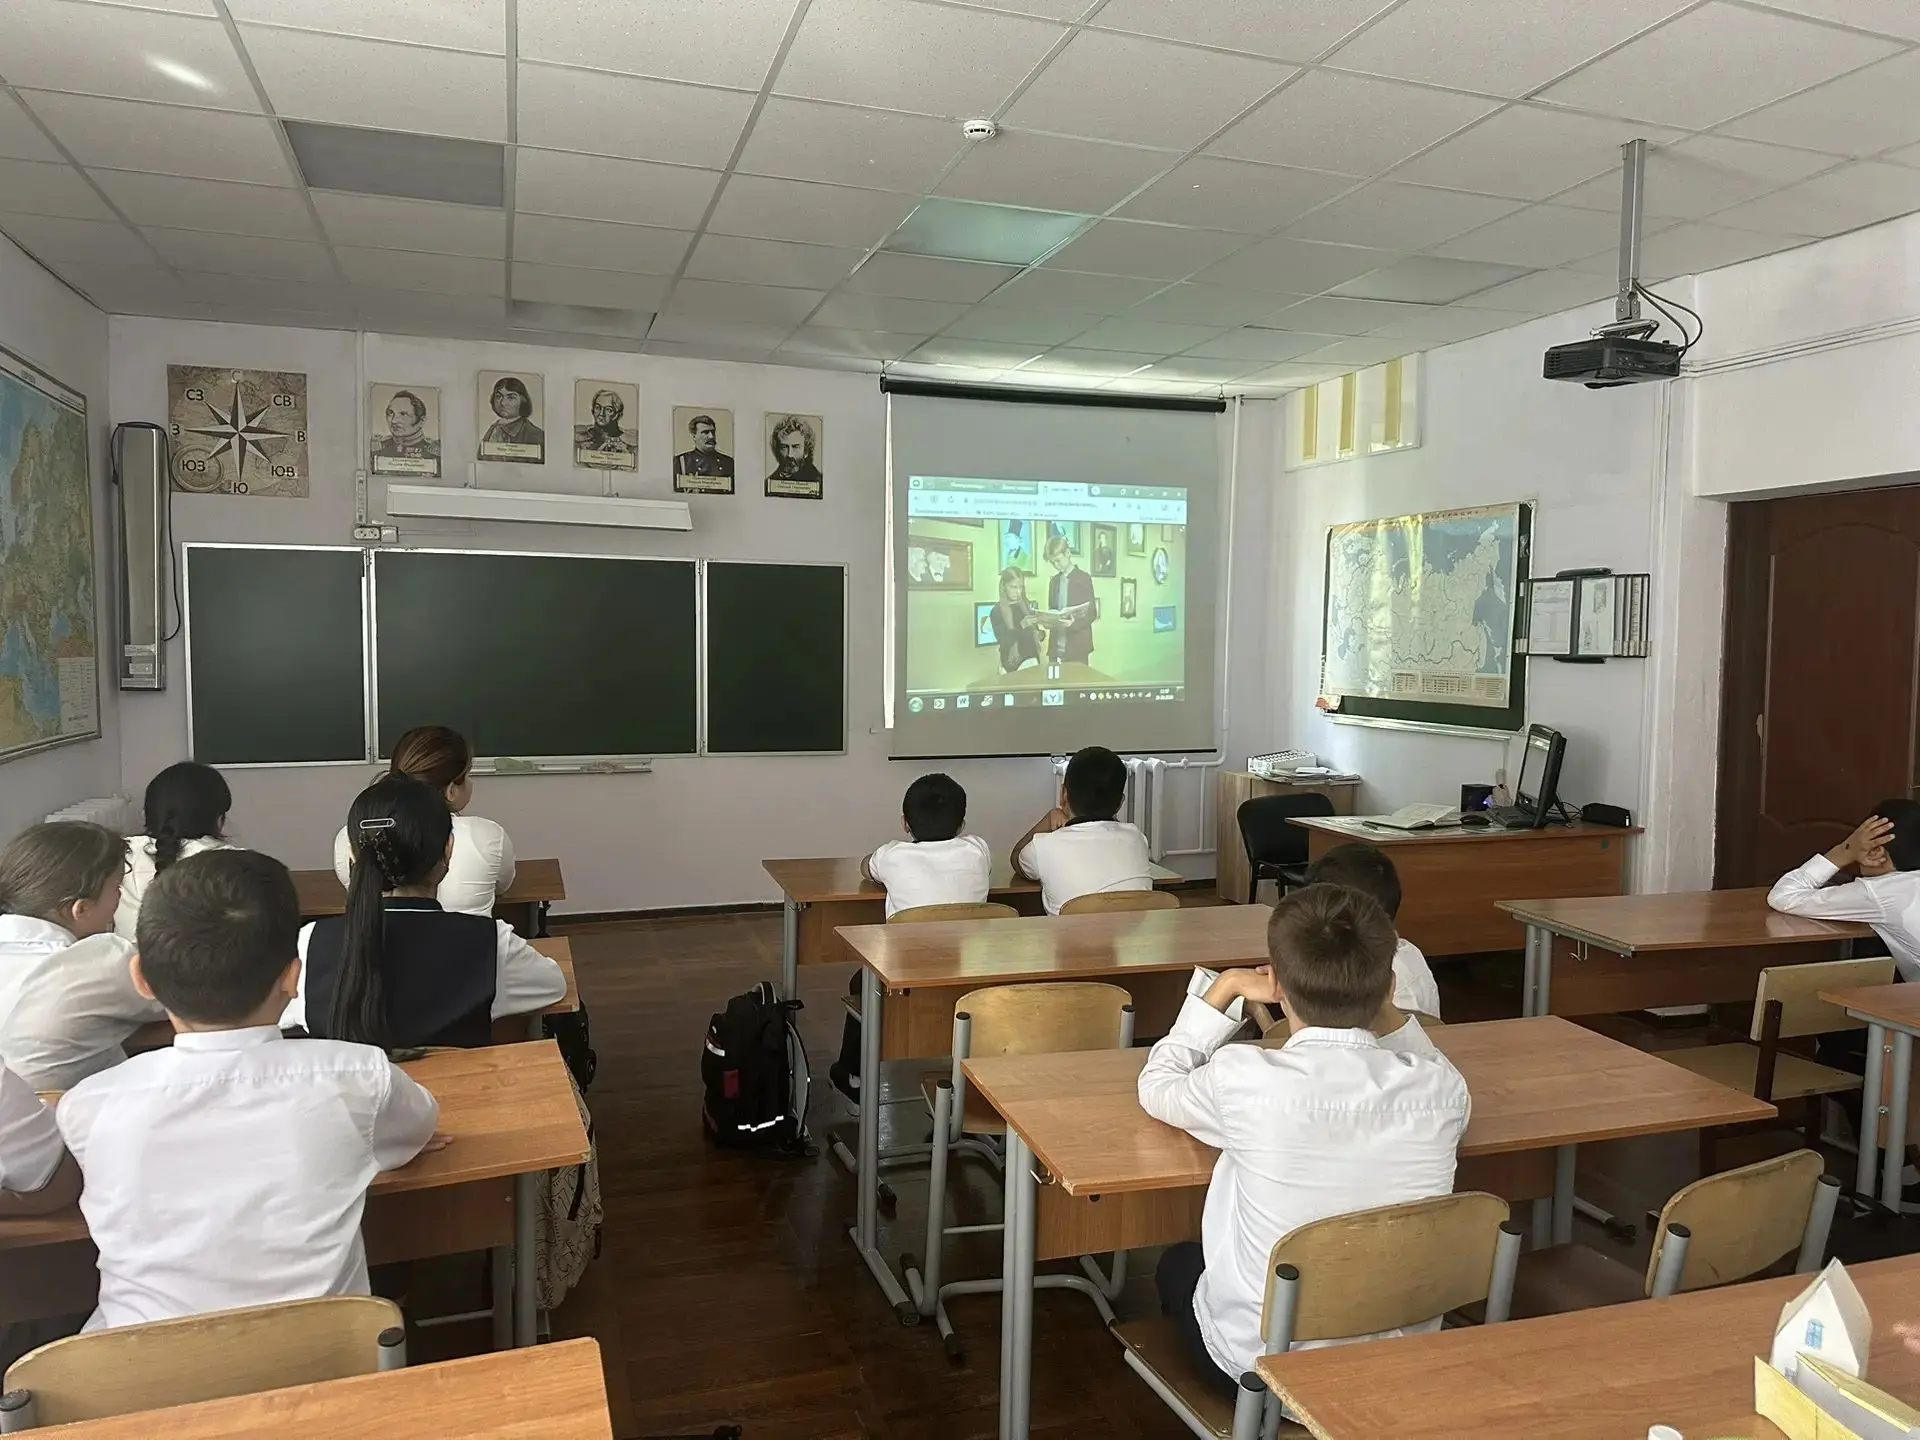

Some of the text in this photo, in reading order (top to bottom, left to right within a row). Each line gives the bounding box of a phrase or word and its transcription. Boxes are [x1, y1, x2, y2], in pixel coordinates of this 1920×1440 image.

[231, 371, 241, 382] С
[186, 389, 204, 401] СЗ
[273, 395, 292, 406] СВ
[171, 424, 180, 435] З
[297, 431, 306, 442] В
[182, 460, 206, 472] ЮЗ
[271, 466, 295, 477] ЮВ
[233, 482, 249, 493] Ю
